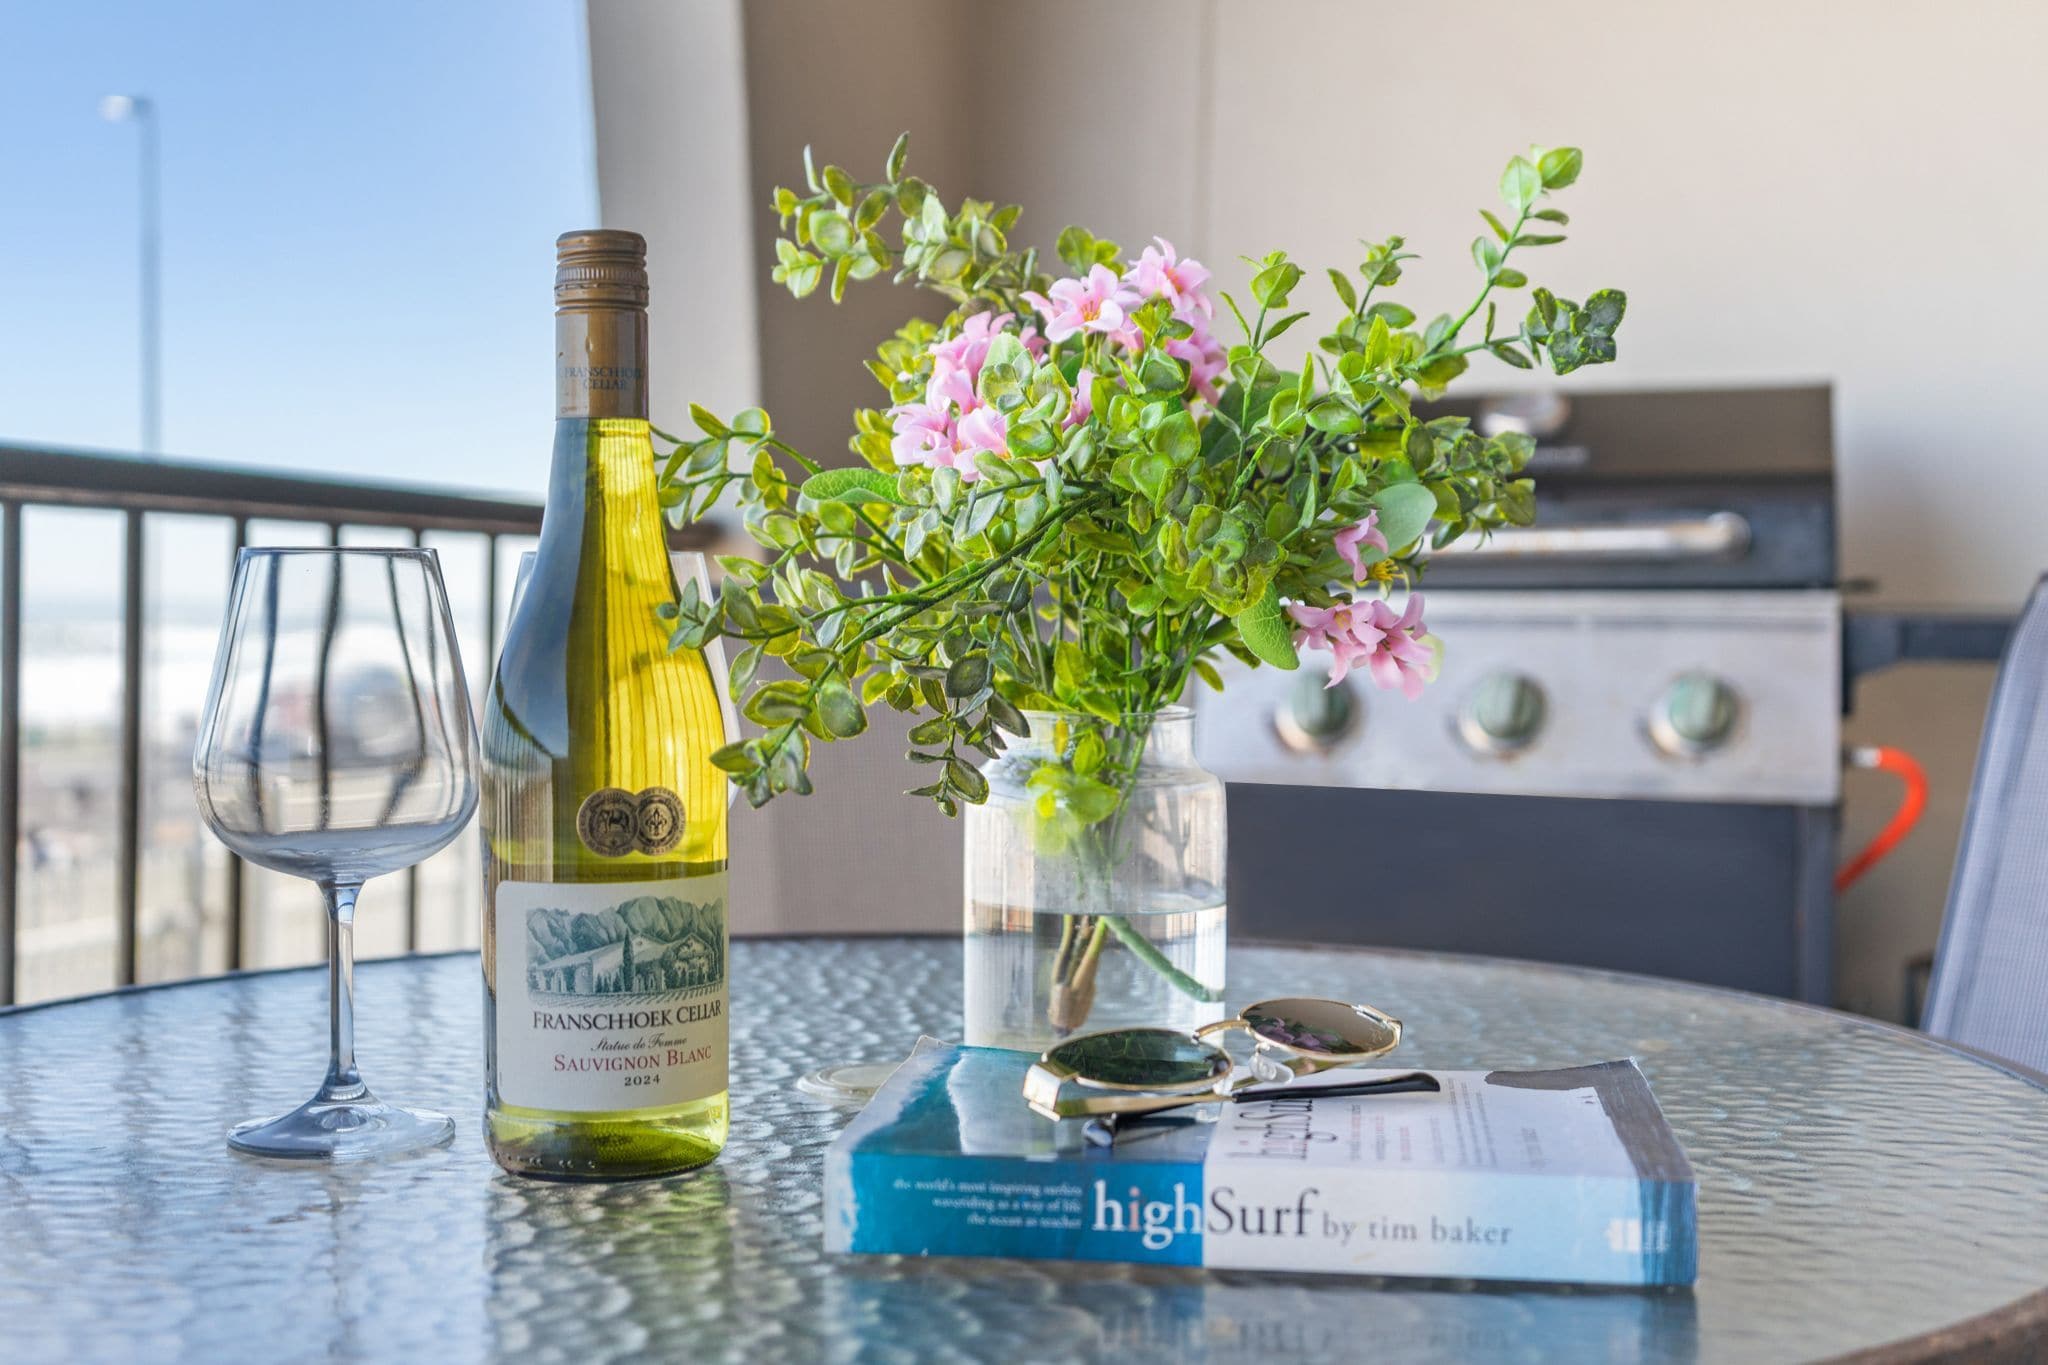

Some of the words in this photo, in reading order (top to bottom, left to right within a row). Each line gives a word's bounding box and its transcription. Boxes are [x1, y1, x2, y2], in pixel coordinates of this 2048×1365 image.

[533, 1010, 673, 1031] FRANSCHHOEK
[676, 999, 722, 1025] CELLAR
[590, 1035, 631, 1052] Statue
[632, 1036, 647, 1050] de
[648, 1032, 688, 1049] Femme
[554, 1053, 661, 1072] SAUVIGNON
[667, 1045, 712, 1065] BLANC
[624, 1074, 661, 1088] 2024
[1323, 1206, 1358, 1243] by
[1369, 1215, 1417, 1240] tim
[1431, 1214, 1513, 1244] baker
